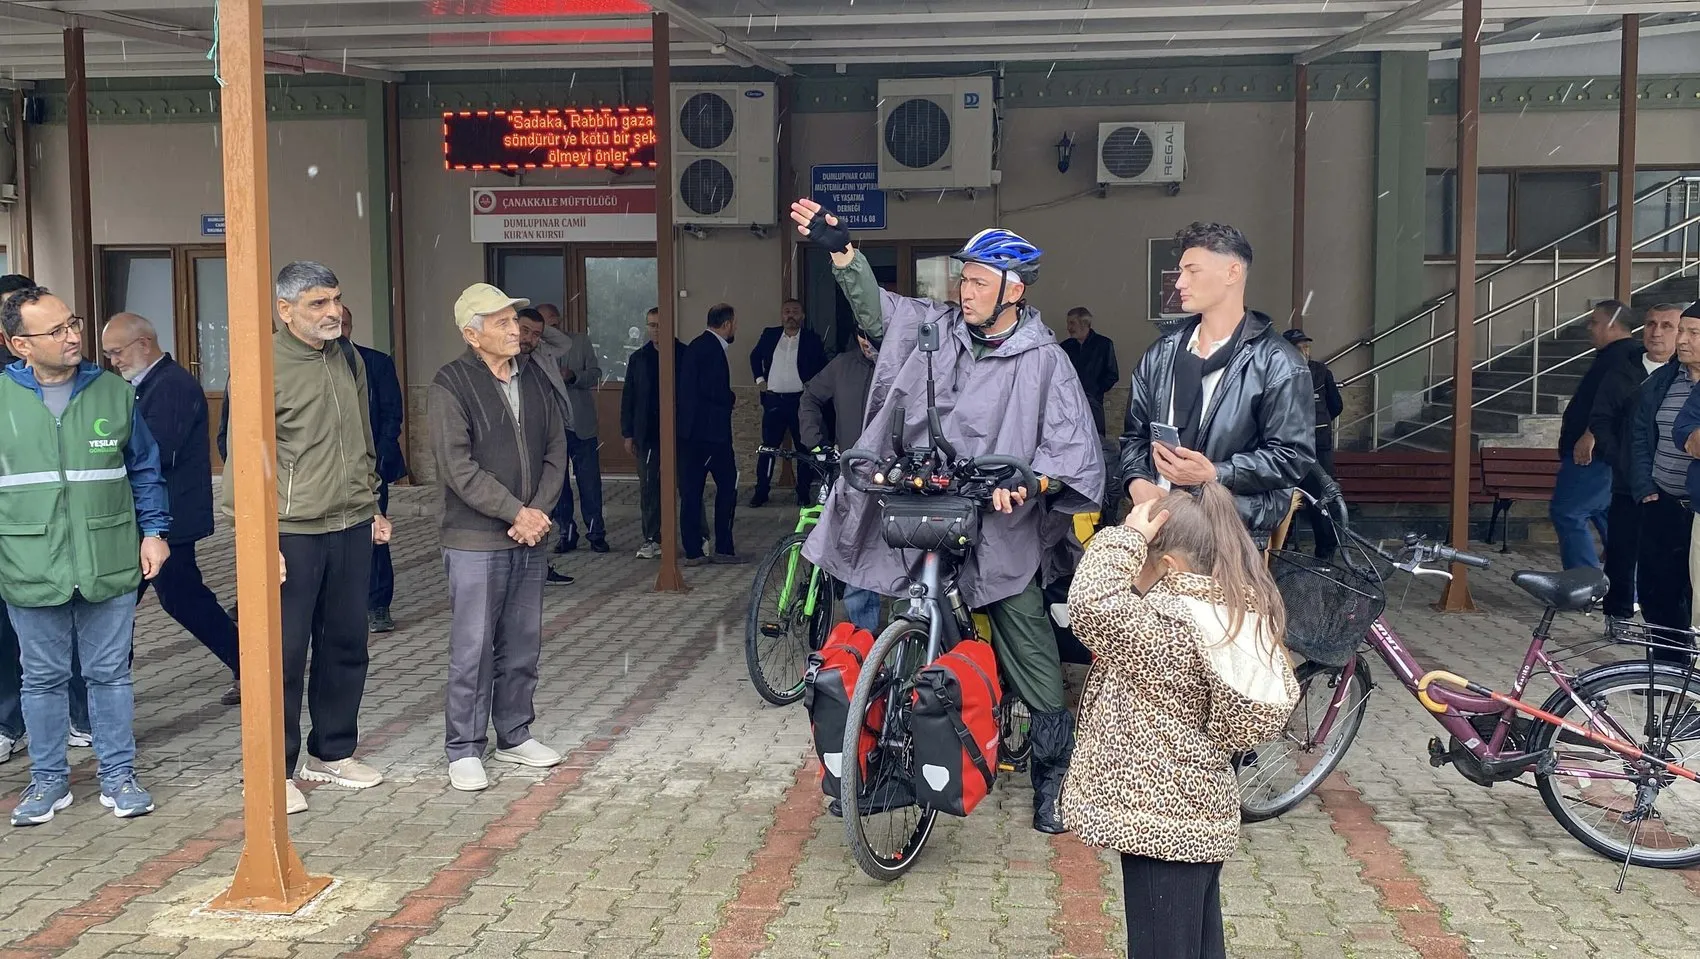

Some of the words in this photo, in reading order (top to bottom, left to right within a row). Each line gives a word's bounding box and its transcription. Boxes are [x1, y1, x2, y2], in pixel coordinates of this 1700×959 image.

[508, 114, 568, 131] "Sadaka,
[571, 113, 618, 128] Rabb'in
[622, 115, 656, 130] gaza
[504, 132, 560, 147] söndürür
[581, 131, 610, 145] kötü
[613, 130, 630, 145] bir
[549, 148, 591, 165] ölmeyi
[1164, 126, 1174, 176] REGAL
[502, 197, 559, 209] ÇANAKKALE
[559, 195, 618, 207] MÜFTÜLÜĞÜ
[832, 194, 840, 202] VE
[503, 218, 560, 228] DUMLUPINAR
[849, 215, 860, 223] 214
[536, 230, 564, 239] KURSU
